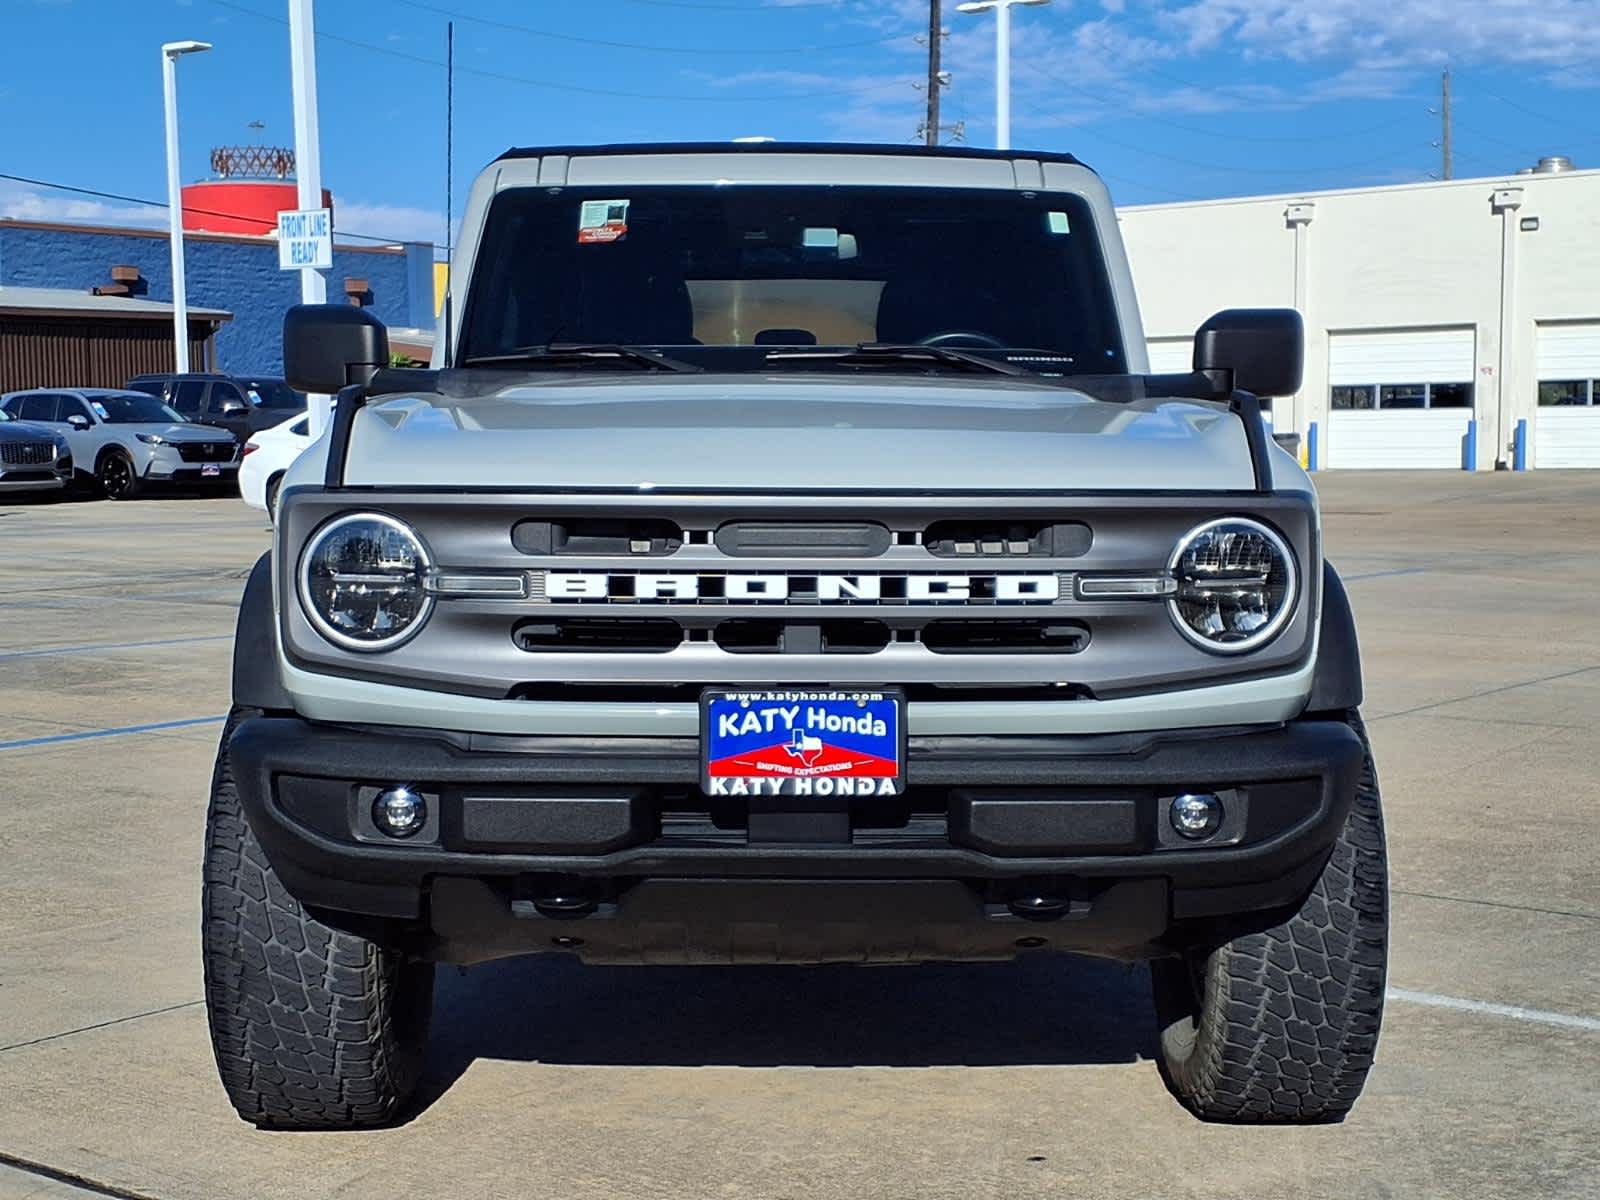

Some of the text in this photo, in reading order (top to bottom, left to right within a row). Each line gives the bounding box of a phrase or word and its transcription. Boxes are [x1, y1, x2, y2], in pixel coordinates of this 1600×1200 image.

[281, 213, 327, 238] FRONT LINE
[291, 240, 319, 264] READY
[545, 573, 1059, 602] BRONCO
[725, 691, 884, 701] www.katyhonda.com
[719, 705, 887, 738] KATY Honda
[756, 761, 853, 776] SHIFTING EXPECTATIONS
[710, 777, 897, 796] KATY HONDA
